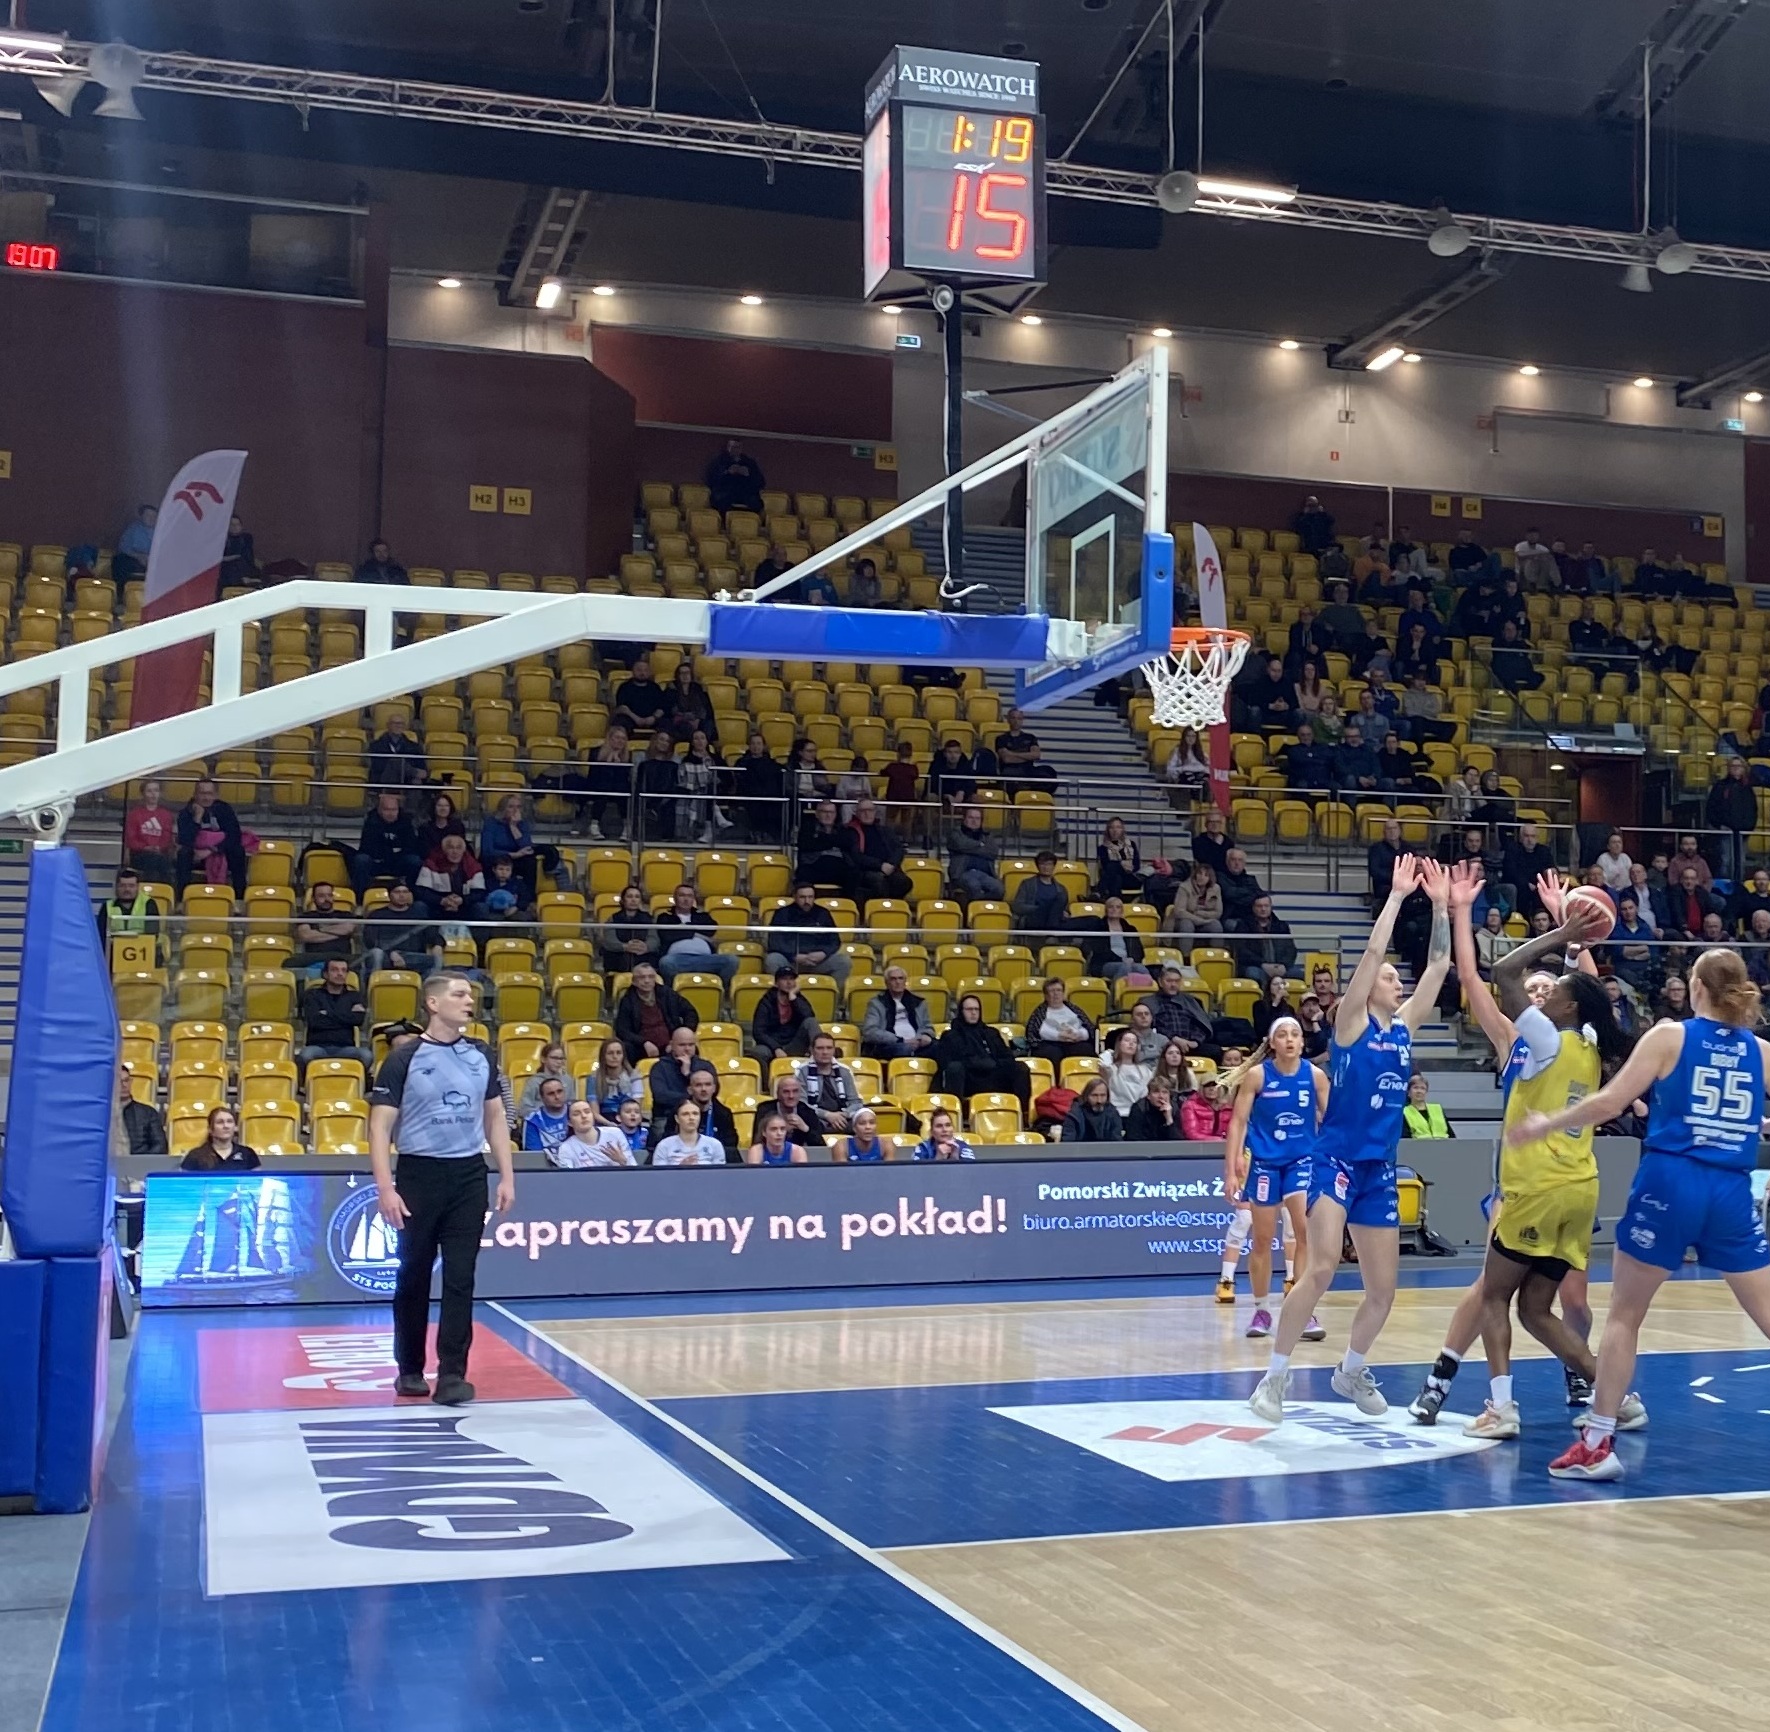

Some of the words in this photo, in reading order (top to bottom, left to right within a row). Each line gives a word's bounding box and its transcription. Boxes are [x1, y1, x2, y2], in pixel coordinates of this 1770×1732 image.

[899, 64, 1036, 97] AEROWATCH
[952, 115, 1034, 162] 1:19
[947, 174, 1027, 260] 15
[122, 946, 147, 961] G1
[1299, 1090, 1309, 1107] 5
[1691, 1066, 1753, 1119] 55
[1038, 1181, 1129, 1201] Pomorski
[1134, 1179, 1209, 1202] Związek
[769, 1214, 826, 1241] na
[841, 1195, 1008, 1251] pokład!
[352, 1273, 372, 1288] STS
[298, 1415, 635, 1552] GDYNIA
